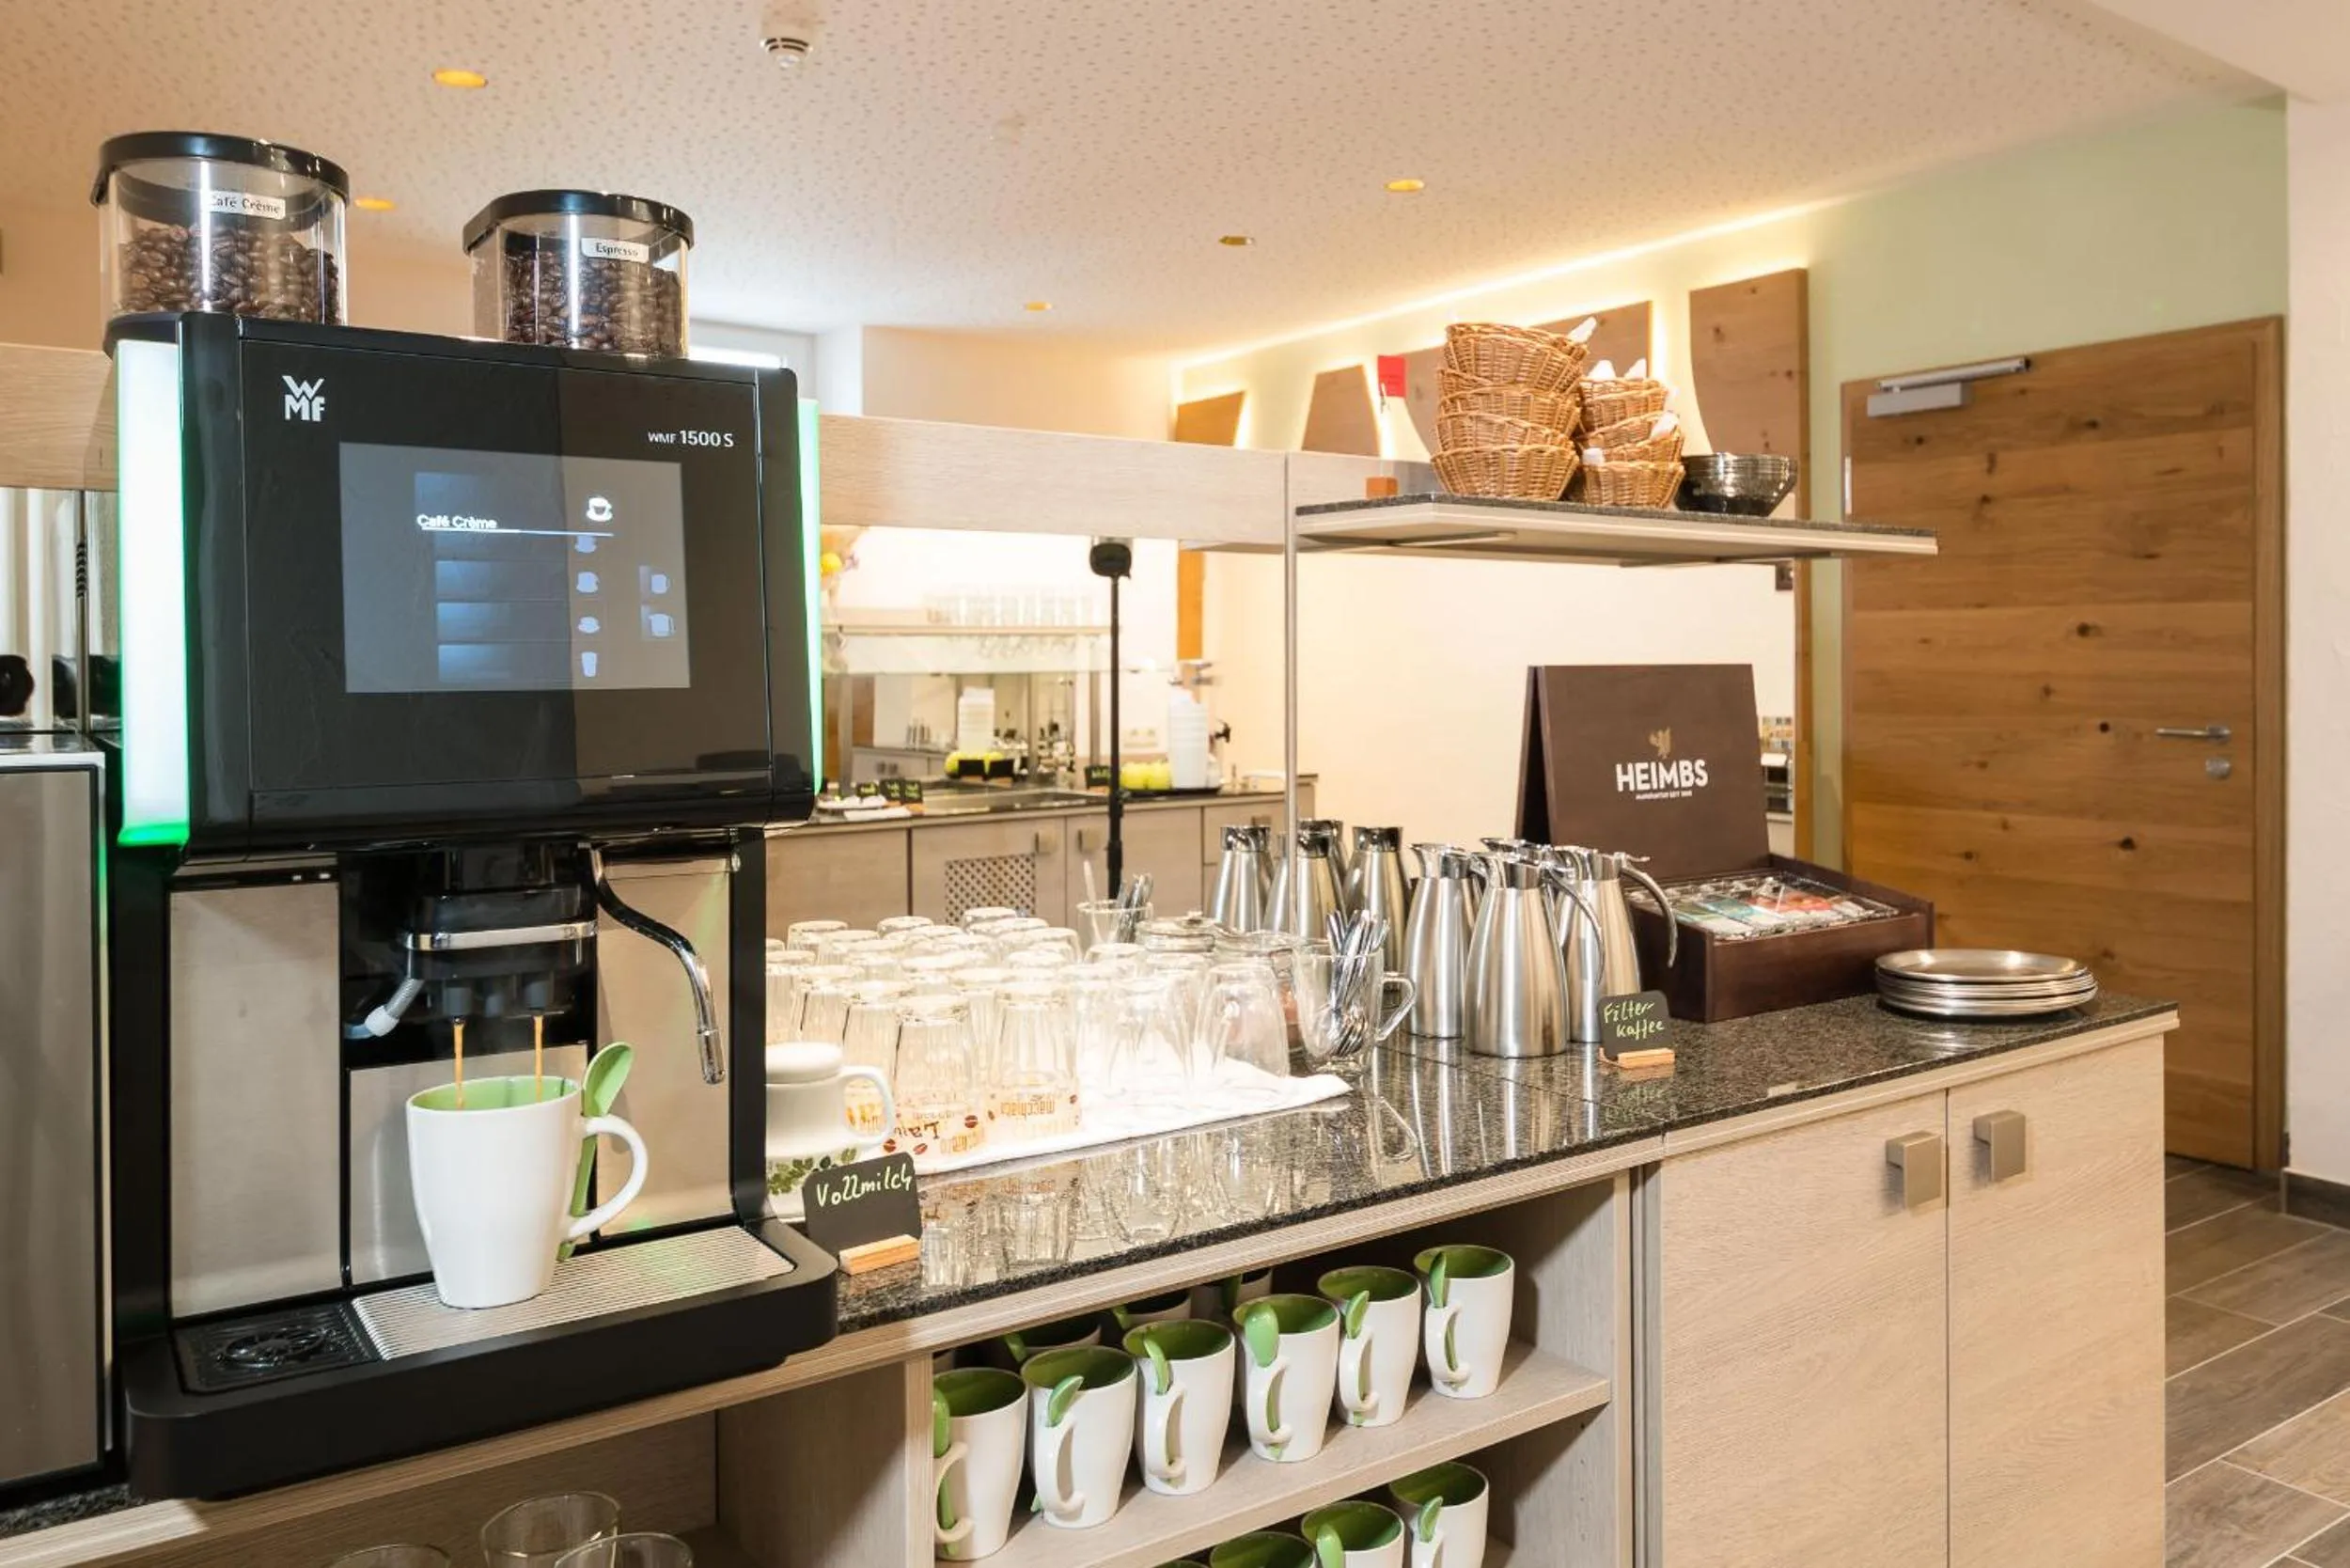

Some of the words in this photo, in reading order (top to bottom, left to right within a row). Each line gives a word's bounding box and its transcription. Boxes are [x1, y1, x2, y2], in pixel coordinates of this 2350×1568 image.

[242, 197, 279, 214] Crème
[595, 242, 639, 257] Espresso
[648, 431, 677, 445] WMF
[680, 430, 721, 447] 1500
[416, 513, 450, 527] Café
[452, 514, 497, 529] Crème
[1615, 759, 1709, 792] HEIMBS
[816, 1163, 914, 1208] Vollmilch
